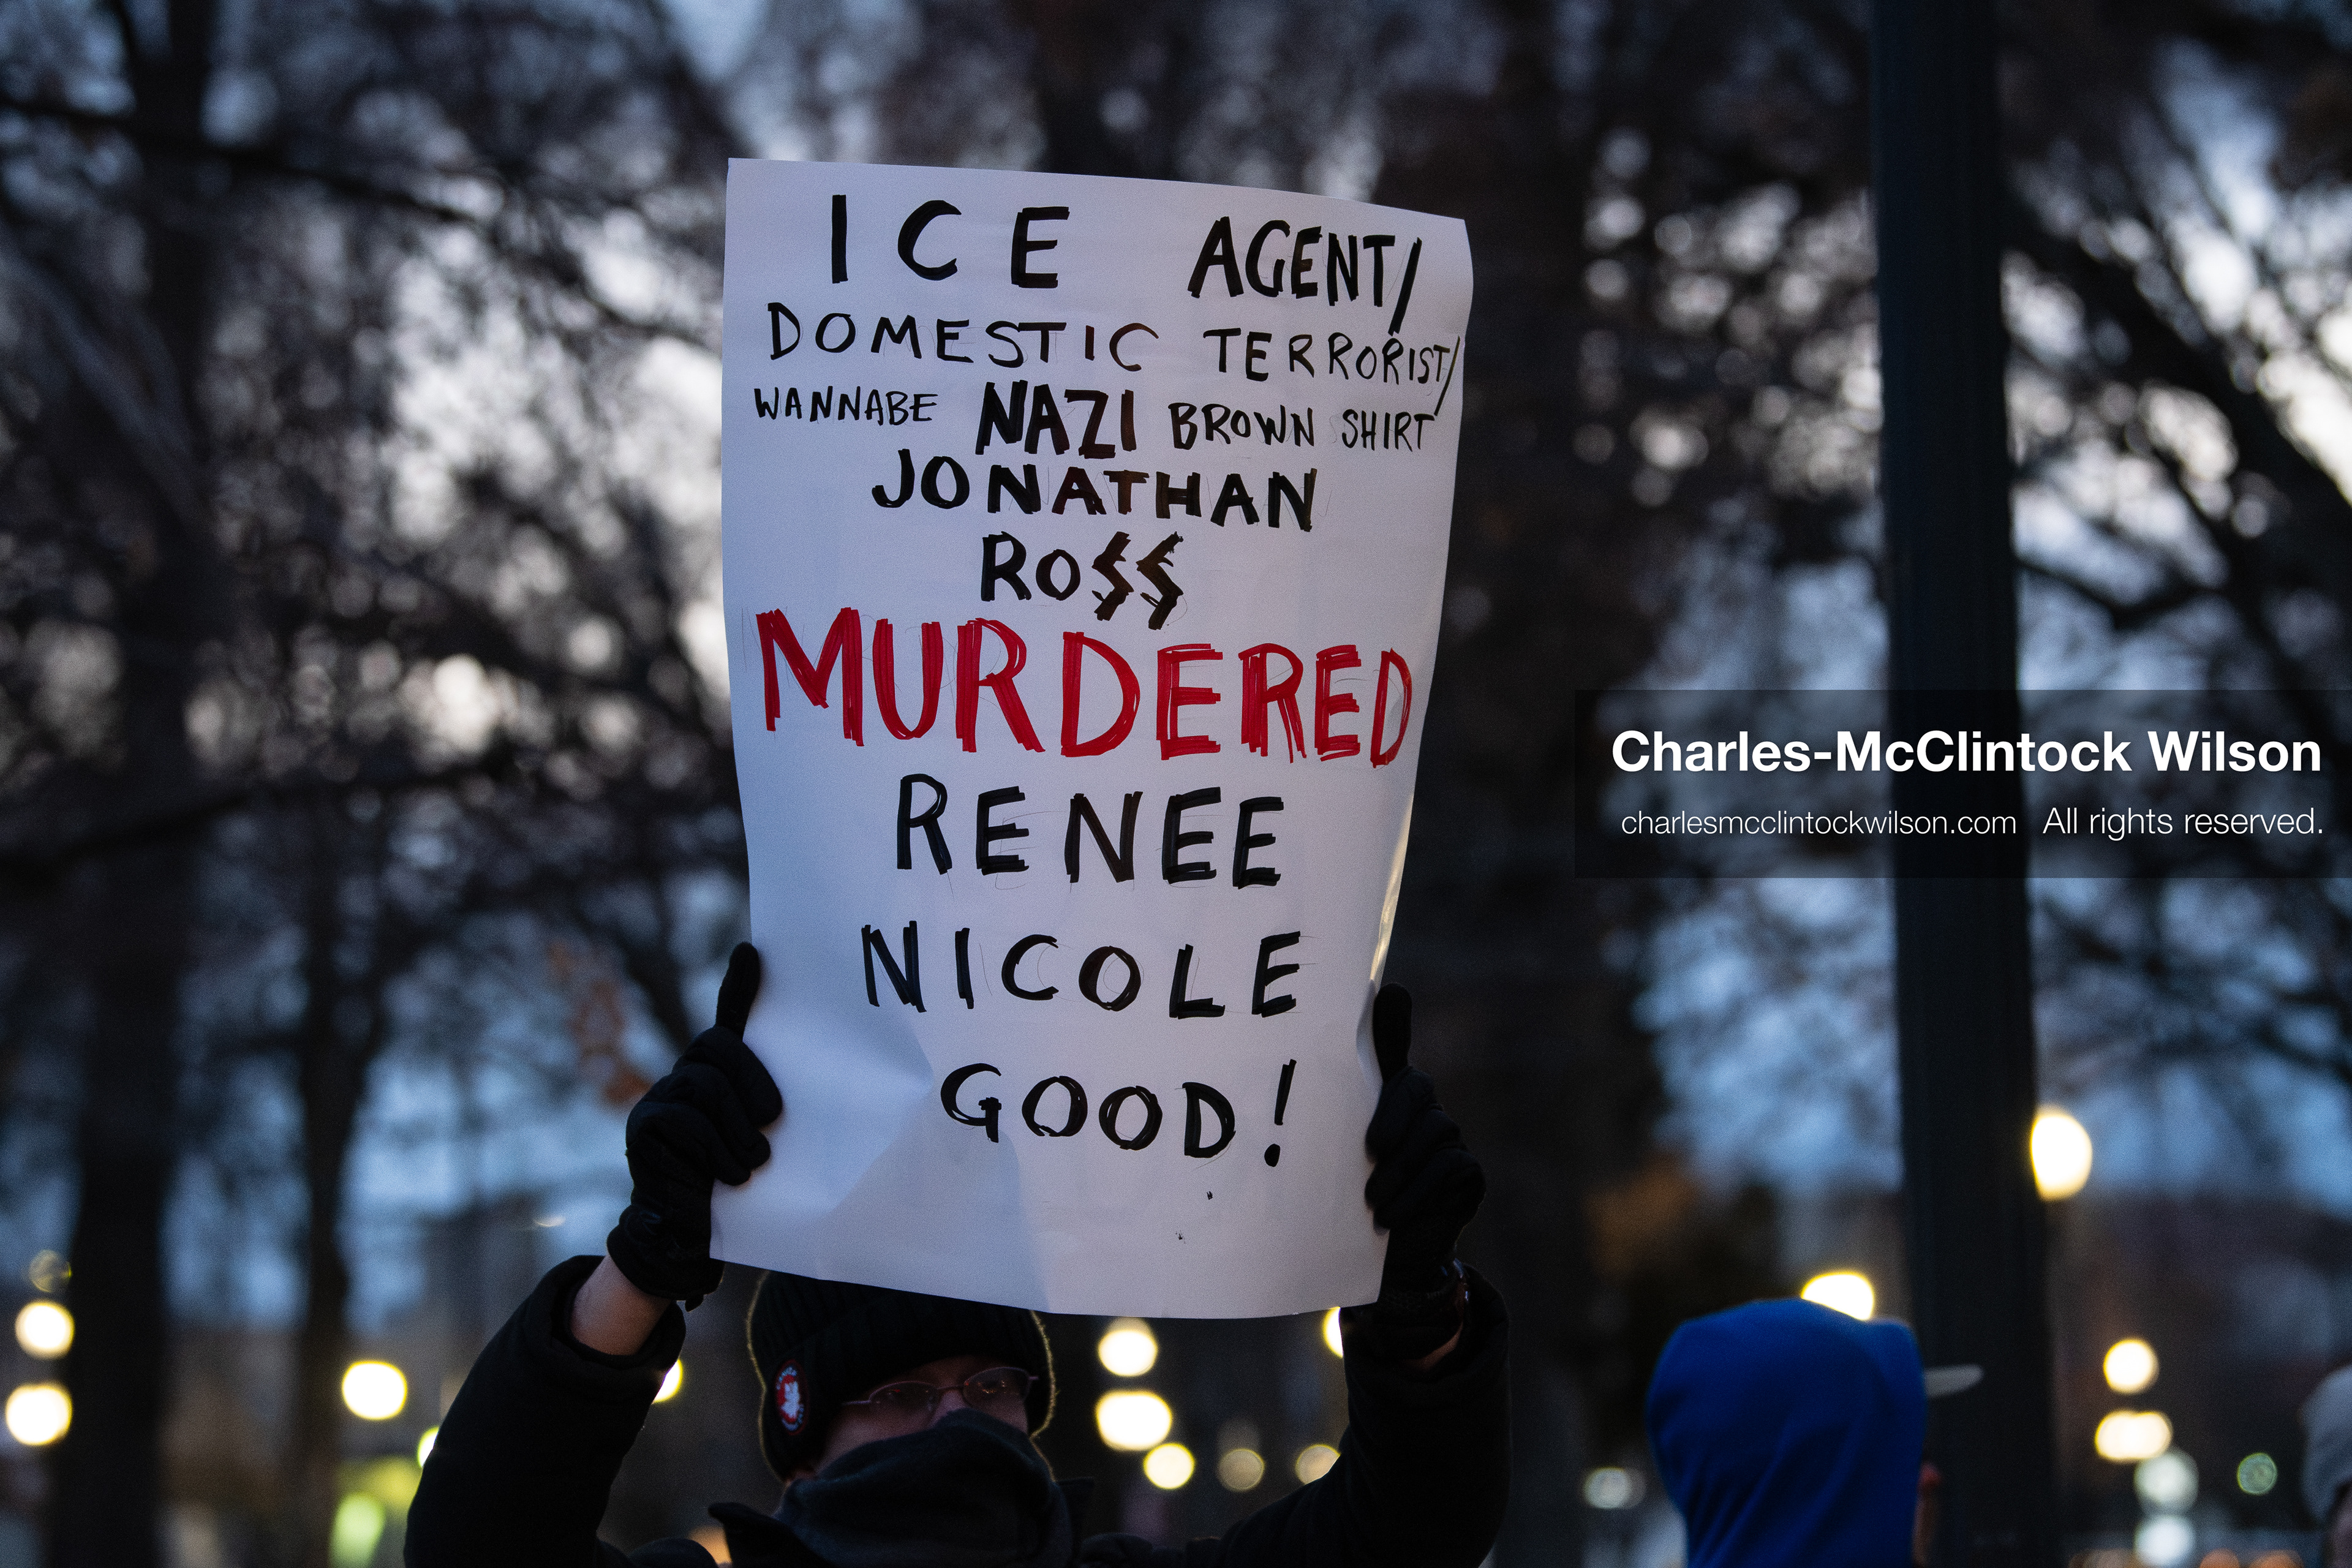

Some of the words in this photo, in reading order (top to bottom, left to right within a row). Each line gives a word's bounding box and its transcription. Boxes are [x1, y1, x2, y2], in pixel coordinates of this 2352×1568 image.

[831, 194, 1070, 289] ICE
[1187, 216, 1423, 336] AGENT/
[767, 302, 1159, 372] DOMESTIC
[754, 385, 938, 426] WANNABE
[975, 379, 1137, 460] NAZI
[1167, 402, 1314, 451] BROWN
[1341, 408, 1436, 452] SHIRT
[872, 448, 1318, 532] JONATHAN
[756, 606, 1413, 769] MURDERED
[897, 773, 1285, 890] RENEE
[861, 920, 1302, 1020] NICOLE
[940, 1058, 1297, 1168] GOOD!
